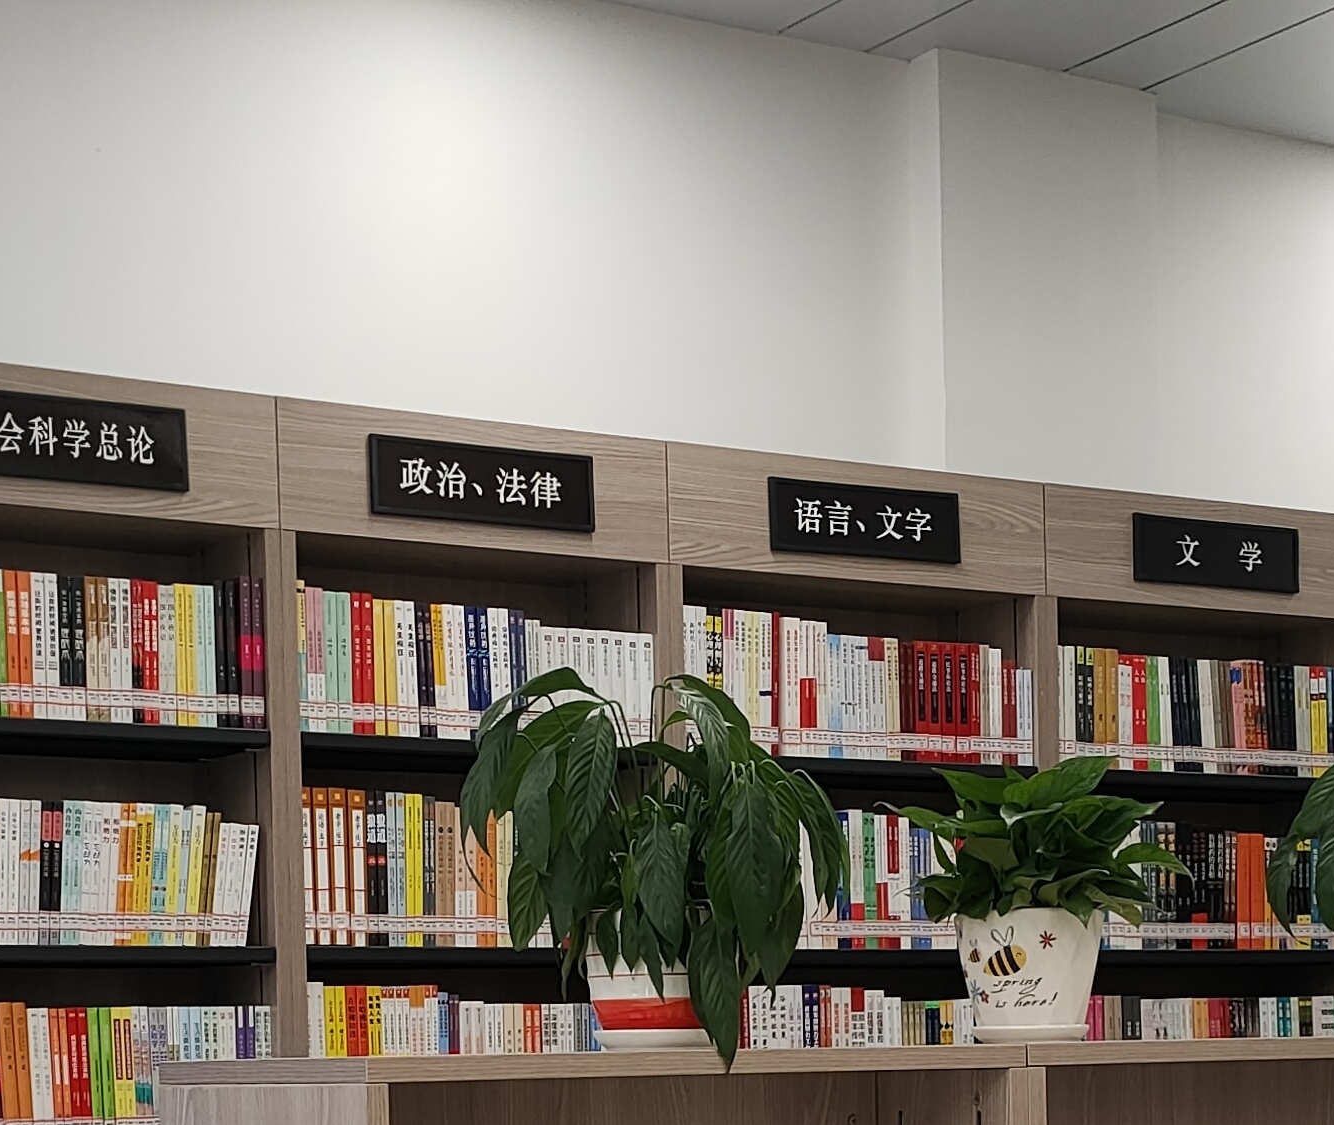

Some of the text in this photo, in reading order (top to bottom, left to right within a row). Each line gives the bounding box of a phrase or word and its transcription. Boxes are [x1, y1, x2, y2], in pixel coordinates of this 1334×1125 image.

[398, 456, 564, 510] 政治、法律
[793, 496, 933, 542] 语言、文字
[991, 977, 1043, 995] spring
